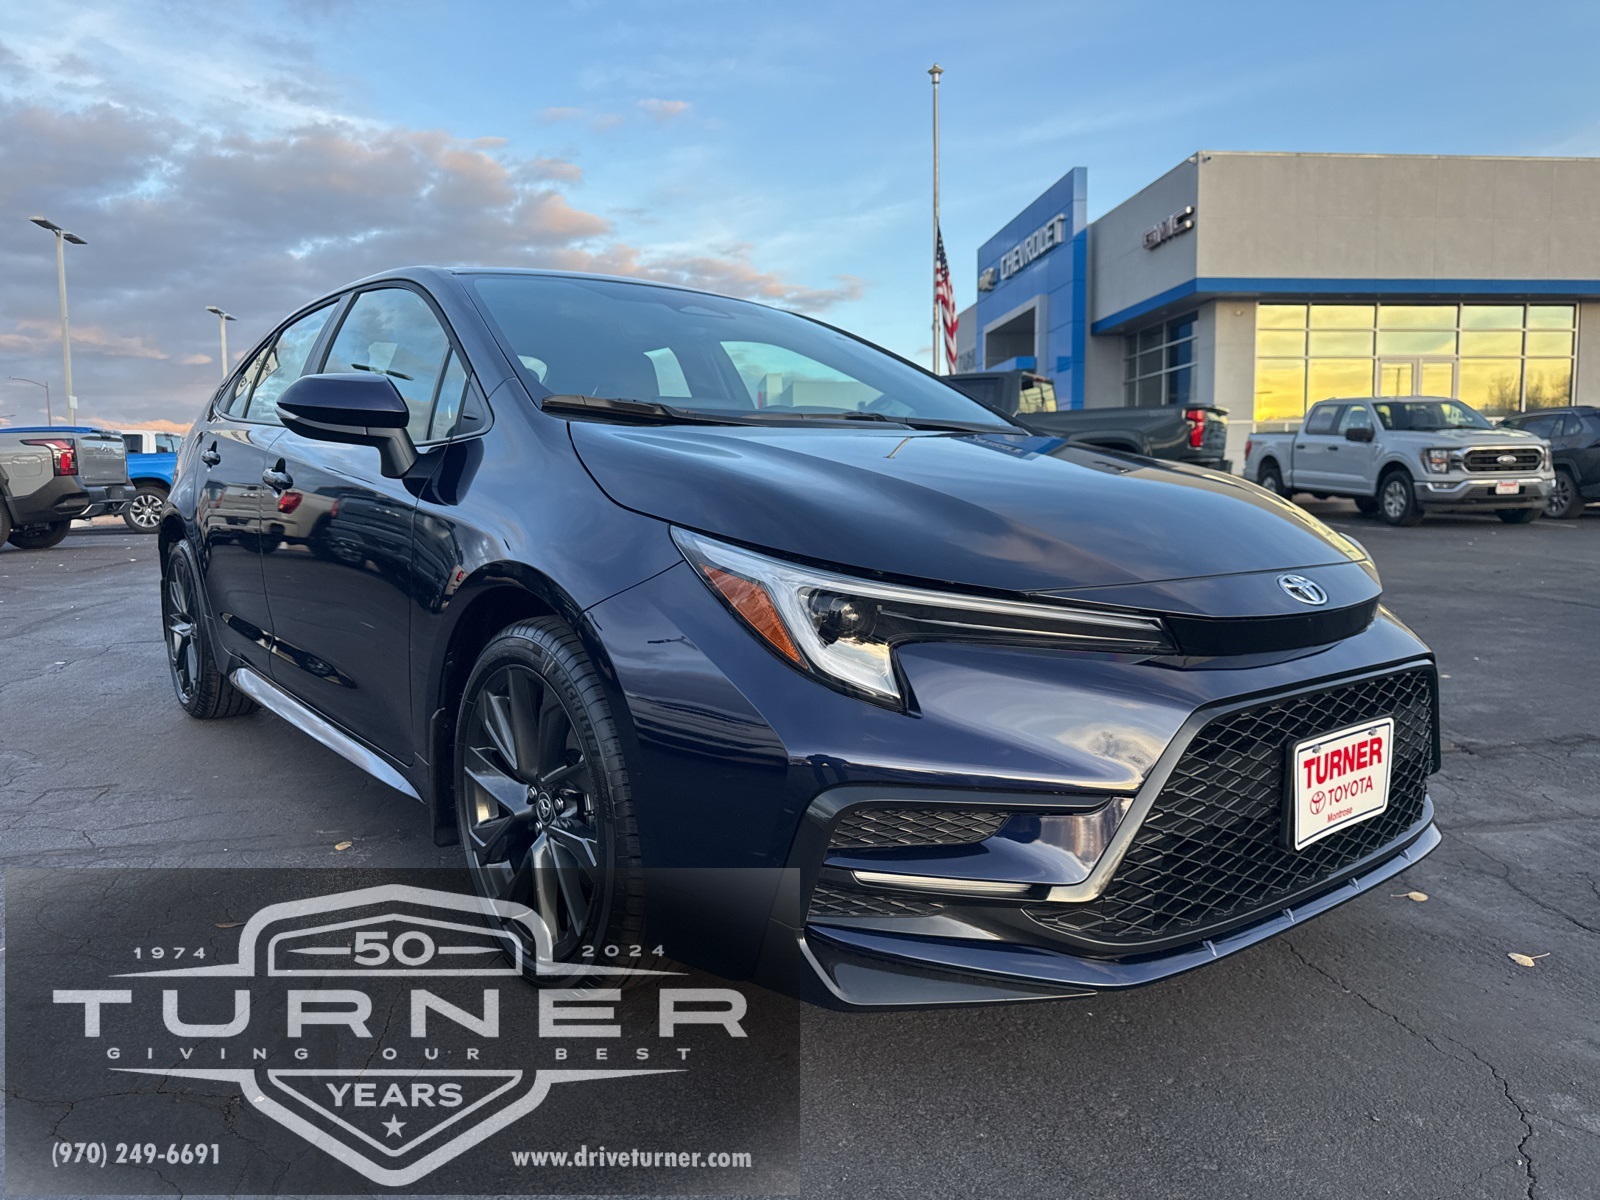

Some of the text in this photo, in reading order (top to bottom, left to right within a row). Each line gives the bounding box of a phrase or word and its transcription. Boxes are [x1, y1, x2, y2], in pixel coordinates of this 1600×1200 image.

[1000, 213, 1067, 280] CHEVROLET
[1142, 205, 1194, 250] GMC
[555, 669, 599, 751] MICHELIN
[1303, 737, 1383, 789] TURNER
[1328, 775, 1373, 806] TOYOTA
[1327, 807, 1353, 823] Montrose
